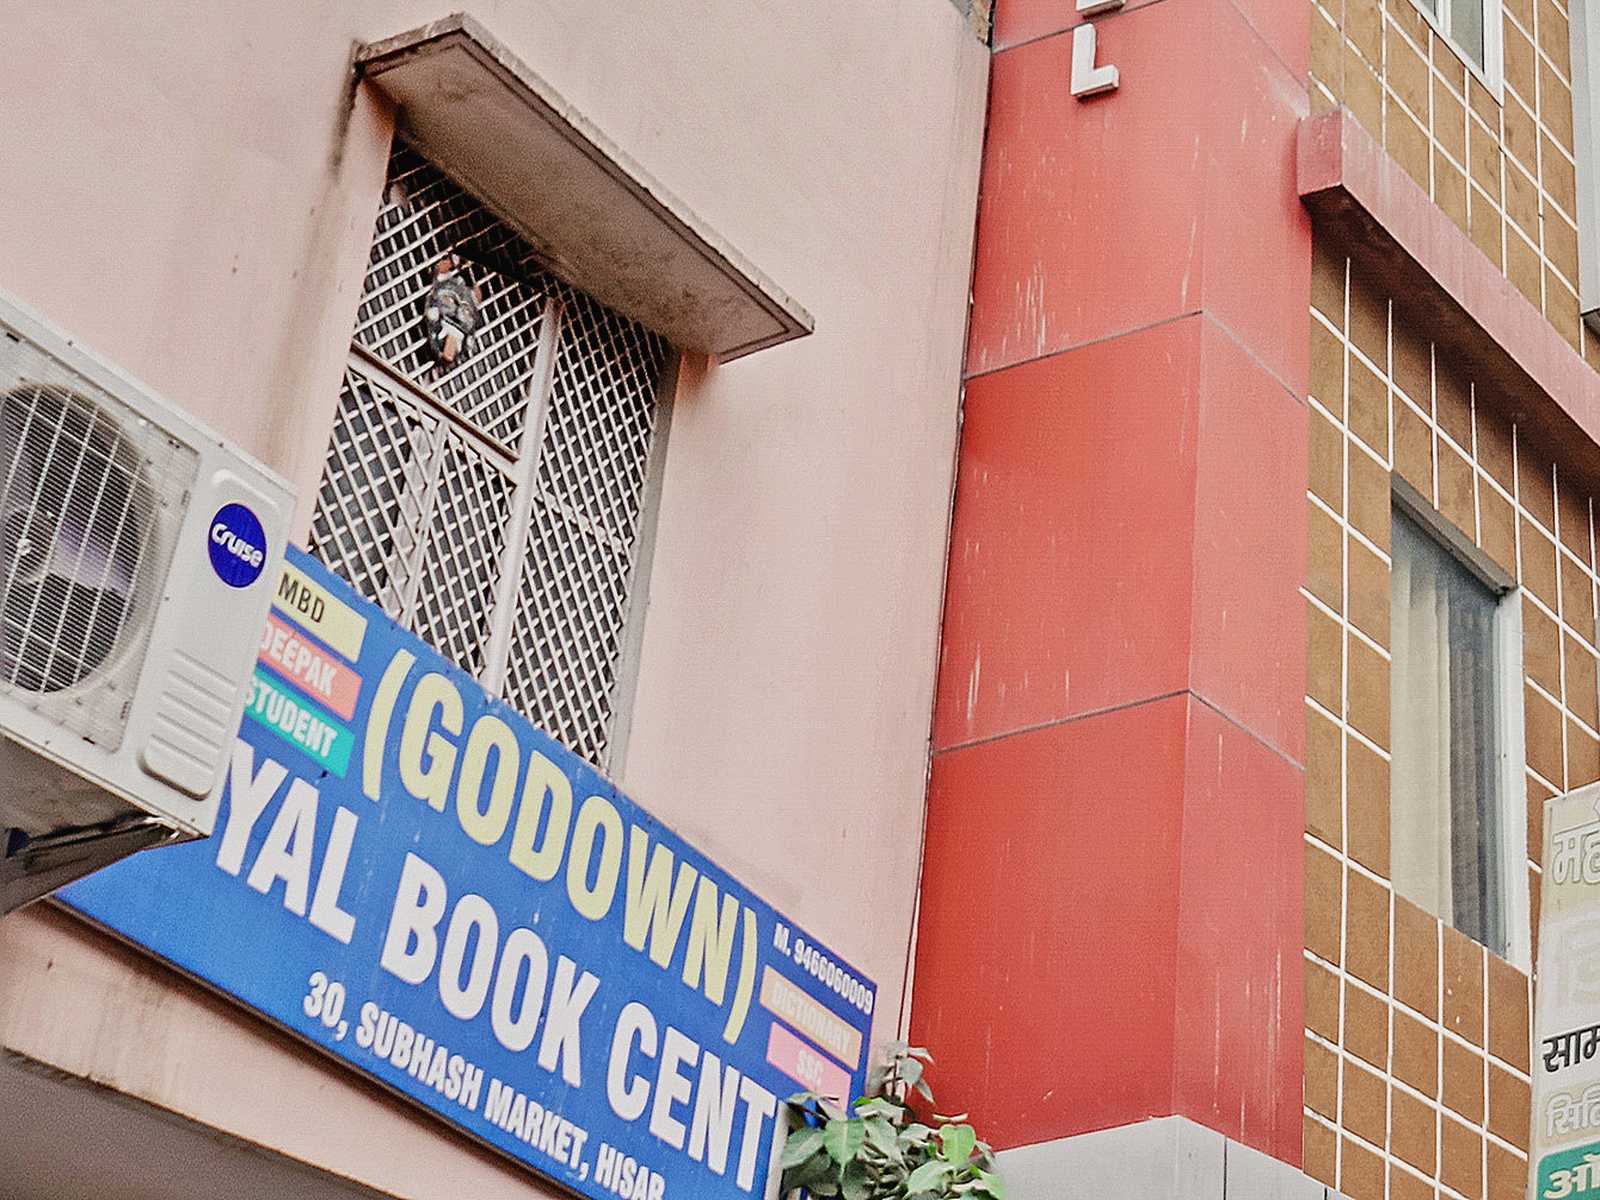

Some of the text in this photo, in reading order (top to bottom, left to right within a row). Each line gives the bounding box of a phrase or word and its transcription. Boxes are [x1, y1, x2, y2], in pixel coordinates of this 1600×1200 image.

[278, 572, 325, 624] MBD
[363, 649, 757, 1043] (GODOWN)
[303, 971, 348, 1042] 30,
[356, 1002, 483, 1112] SUBHASH
[484, 1074, 589, 1182] MARKET,
[380, 852, 599, 1087] BOOK
[606, 1001, 788, 1200] CENT
